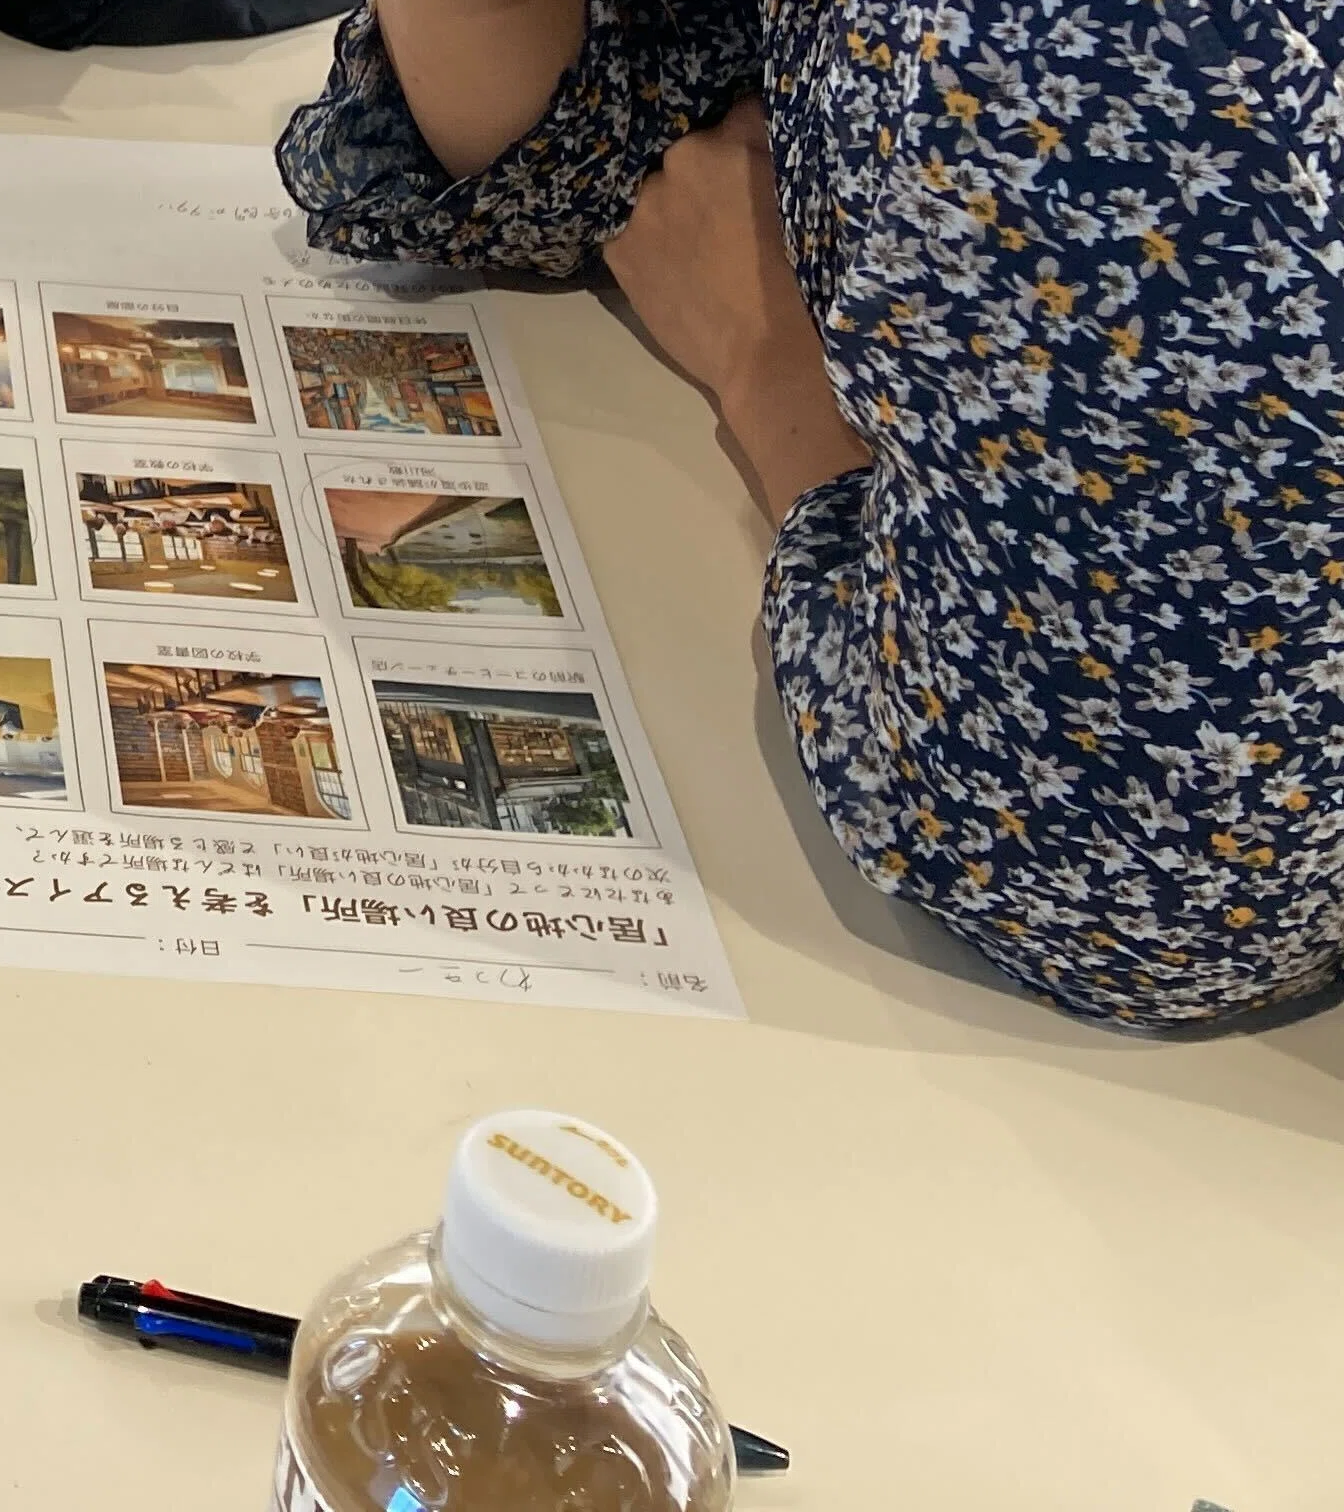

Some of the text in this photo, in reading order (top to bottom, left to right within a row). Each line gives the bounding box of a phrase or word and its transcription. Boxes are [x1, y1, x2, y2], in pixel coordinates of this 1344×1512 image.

[132, 457, 214, 473] 学校の教室
[156, 644, 262, 664] 学校の図書室
[370, 658, 586, 685] 駅前のコーヒーチェーン店
[486, 1133, 633, 1225] SUNTORY
